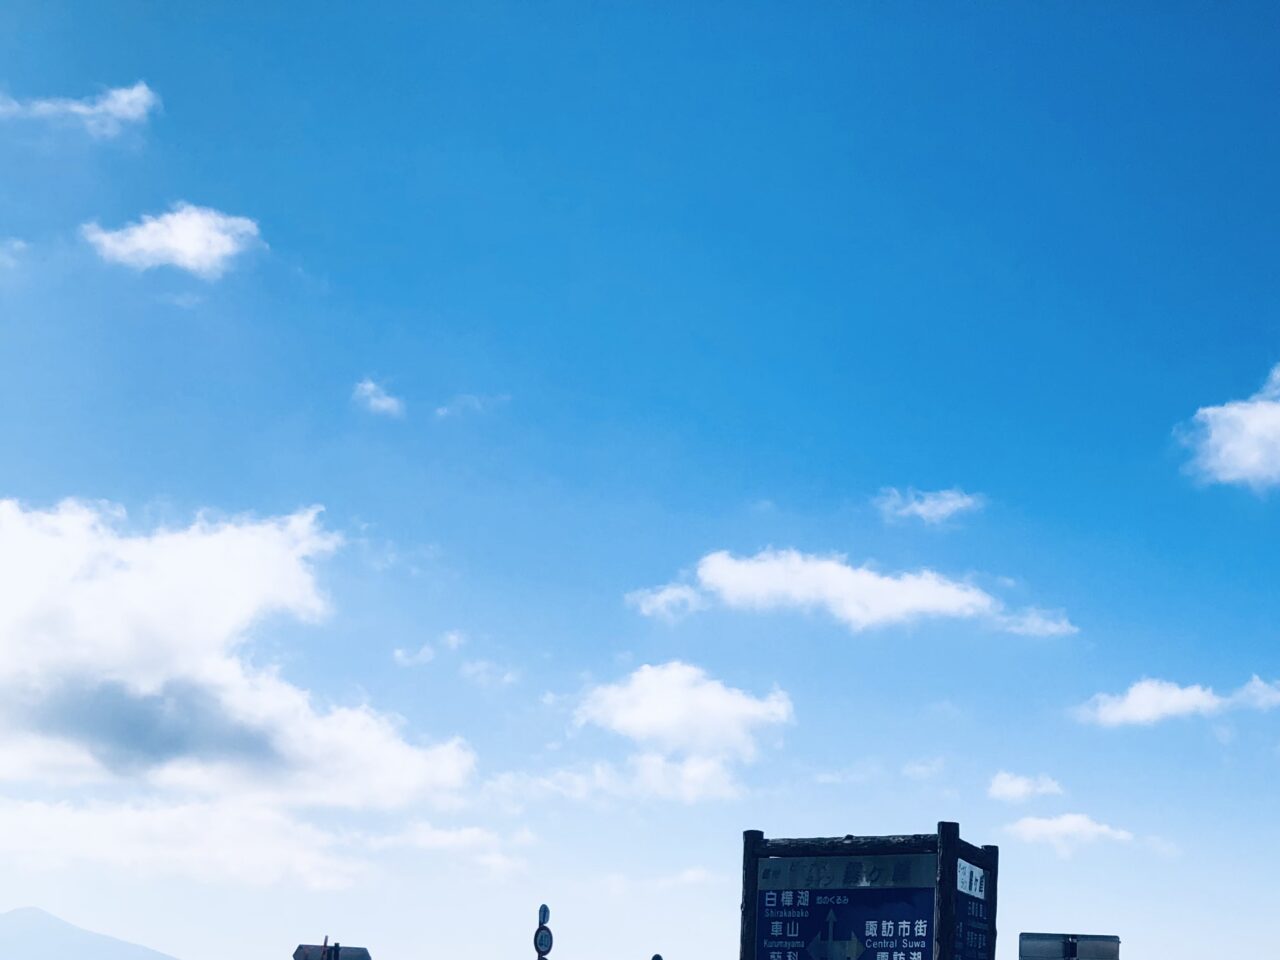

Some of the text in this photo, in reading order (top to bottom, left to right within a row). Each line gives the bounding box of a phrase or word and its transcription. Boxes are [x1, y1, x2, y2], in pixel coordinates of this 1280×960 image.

[765, 890, 810, 907] 白樺湖
[770, 921, 799, 937] 車山
[864, 919, 928, 937] 諏訪市街
[865, 939, 926, 948] Central Suwa
